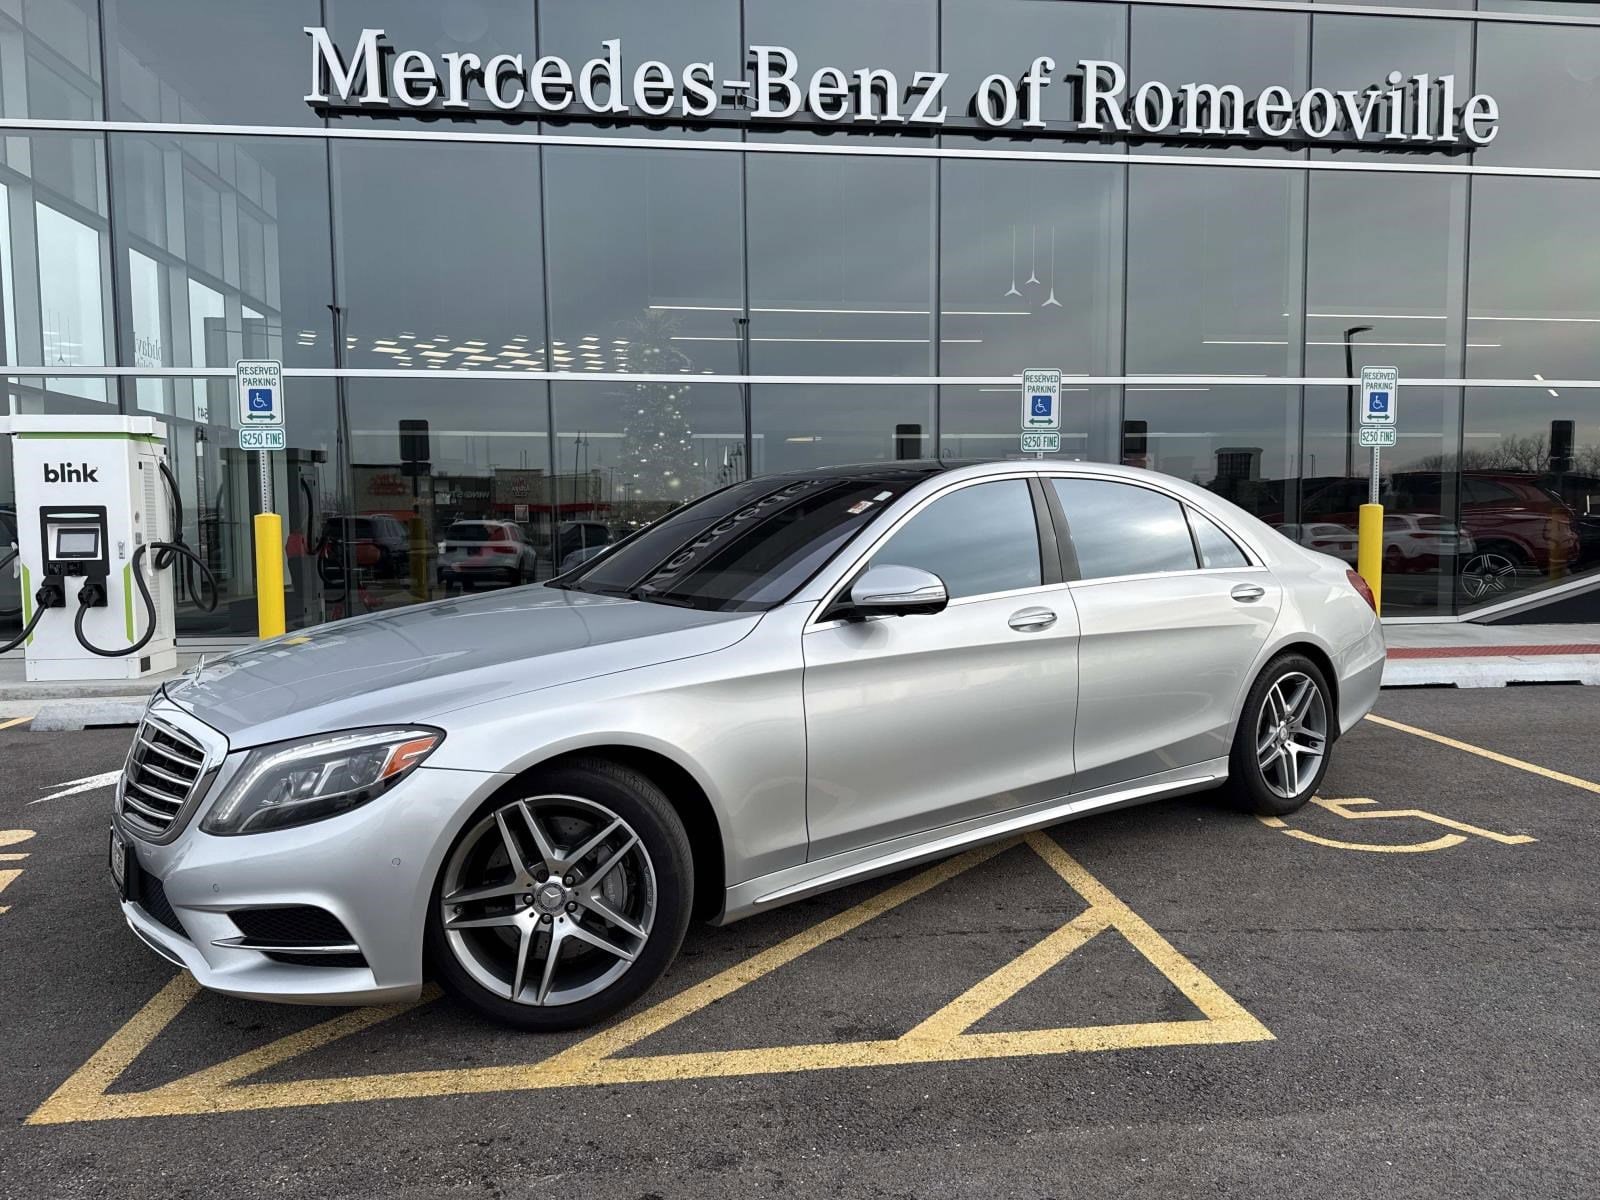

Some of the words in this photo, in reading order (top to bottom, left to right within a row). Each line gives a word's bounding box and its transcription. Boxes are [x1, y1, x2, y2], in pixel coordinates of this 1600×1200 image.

[303, 25, 951, 124] Mercedes-Benz
[977, 56, 1056, 129] of
[1077, 59, 1500, 144] Romeoville
[239, 366, 279, 376] RESERVED
[1363, 372, 1395, 380] RESERVED
[242, 378, 277, 387] PARKING
[1026, 374, 1058, 383] RESERVED
[1365, 382, 1393, 390] PARKING
[242, 432, 263, 445] $250
[265, 432, 282, 445] FINE
[1023, 435, 1041, 448] $250
[1043, 436, 1057, 447] FINE
[1362, 431, 1378, 442] $250
[1380, 431, 1393, 442] FINE
[43, 462, 99, 483] blink
